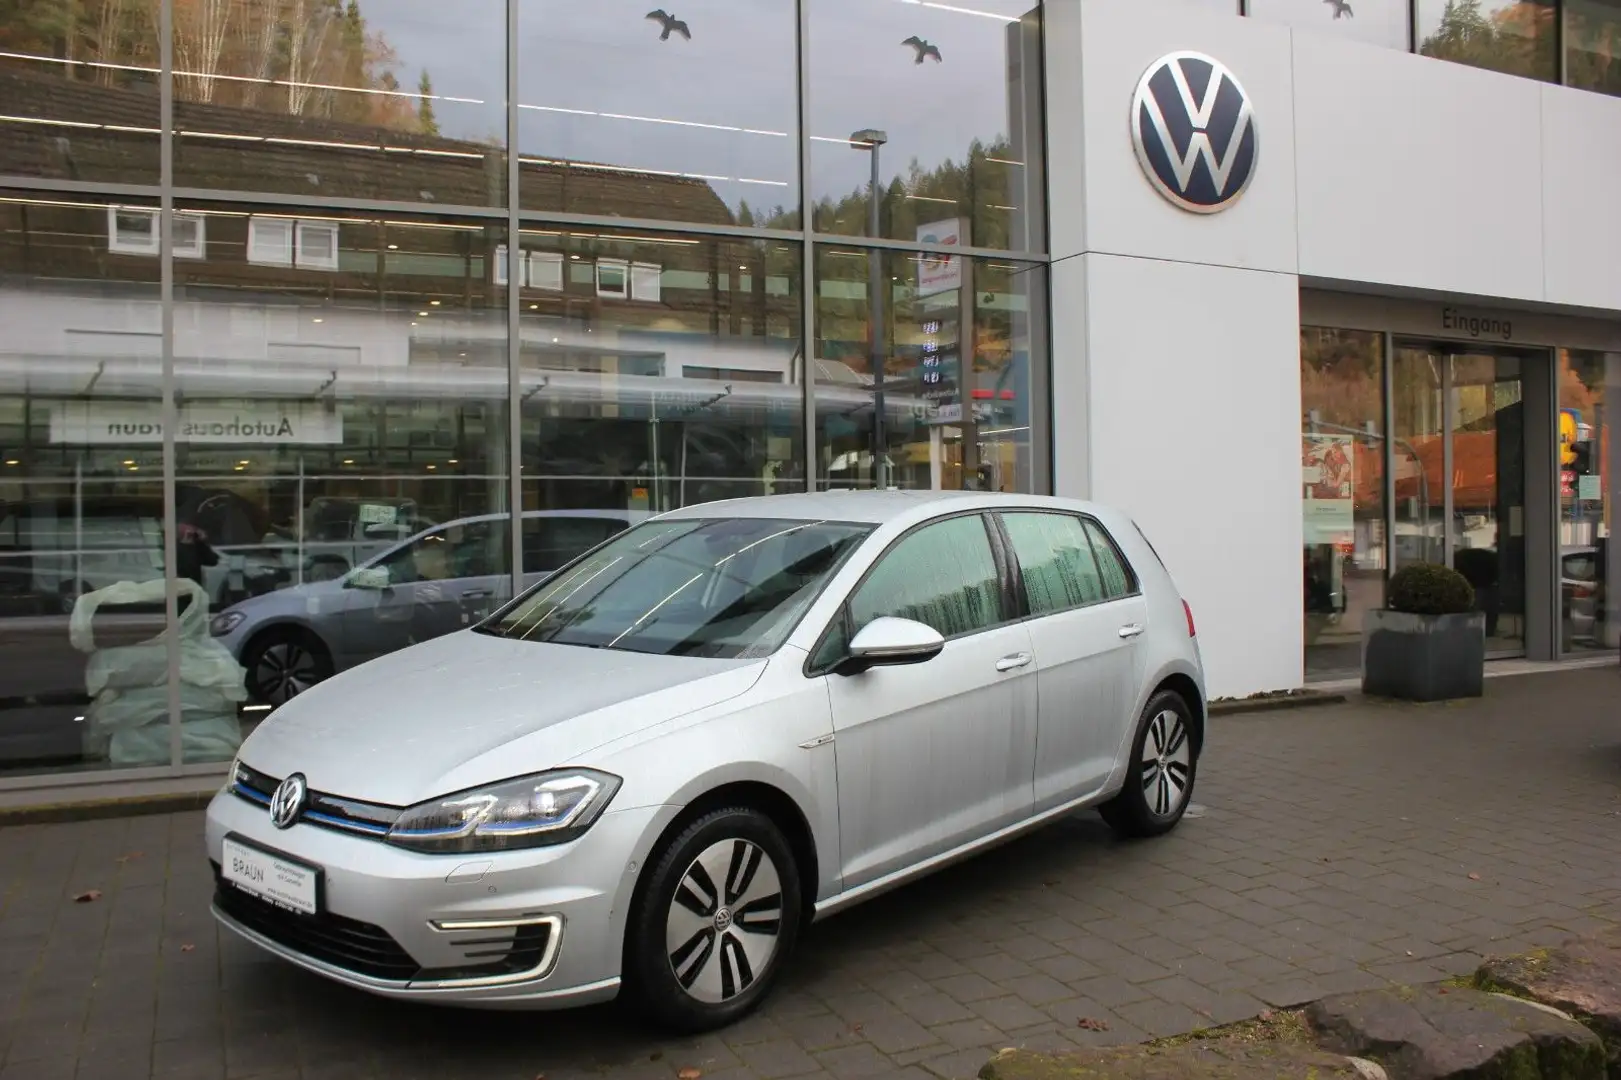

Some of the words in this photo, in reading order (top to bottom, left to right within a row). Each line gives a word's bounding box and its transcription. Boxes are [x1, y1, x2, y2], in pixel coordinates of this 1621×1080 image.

[1133, 53, 1256, 209] VW
[1442, 307, 1512, 340] Eingang
[271, 775, 305, 828] VW
[233, 857, 264, 883] BRAUN
